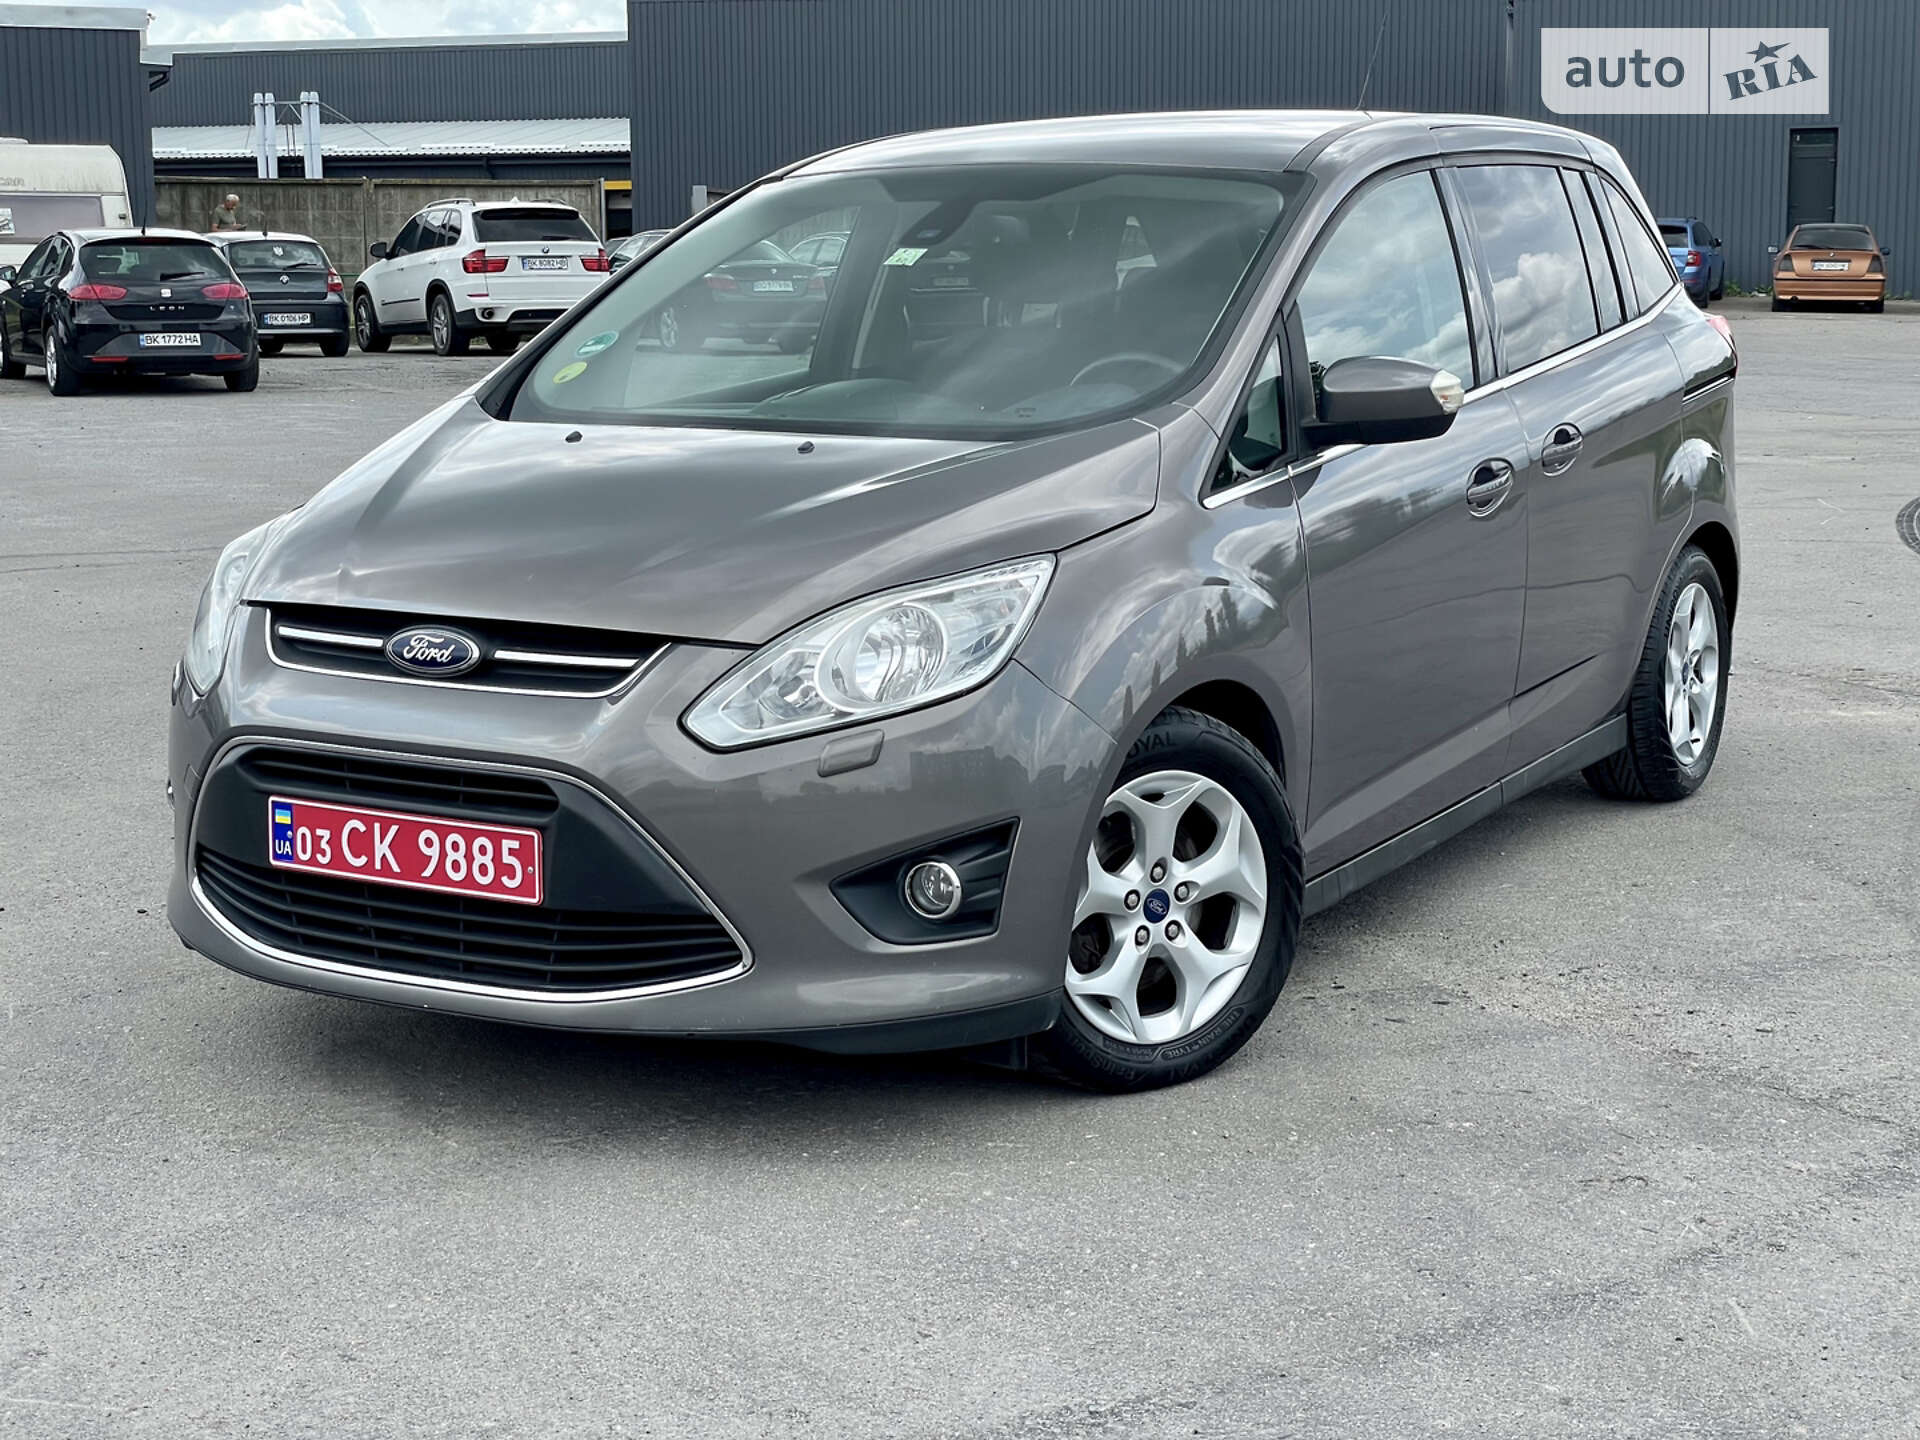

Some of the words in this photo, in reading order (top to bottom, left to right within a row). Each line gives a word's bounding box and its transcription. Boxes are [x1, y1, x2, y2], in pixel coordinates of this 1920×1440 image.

[145, 335, 160, 345] BK
[161, 334, 183, 344] 1772
[185, 334, 199, 344] HA
[403, 635, 456, 663] Ford
[275, 839, 293, 856] UA
[296, 826, 332, 865] 03
[341, 819, 401, 873] CK
[418, 829, 523, 889] 9885
